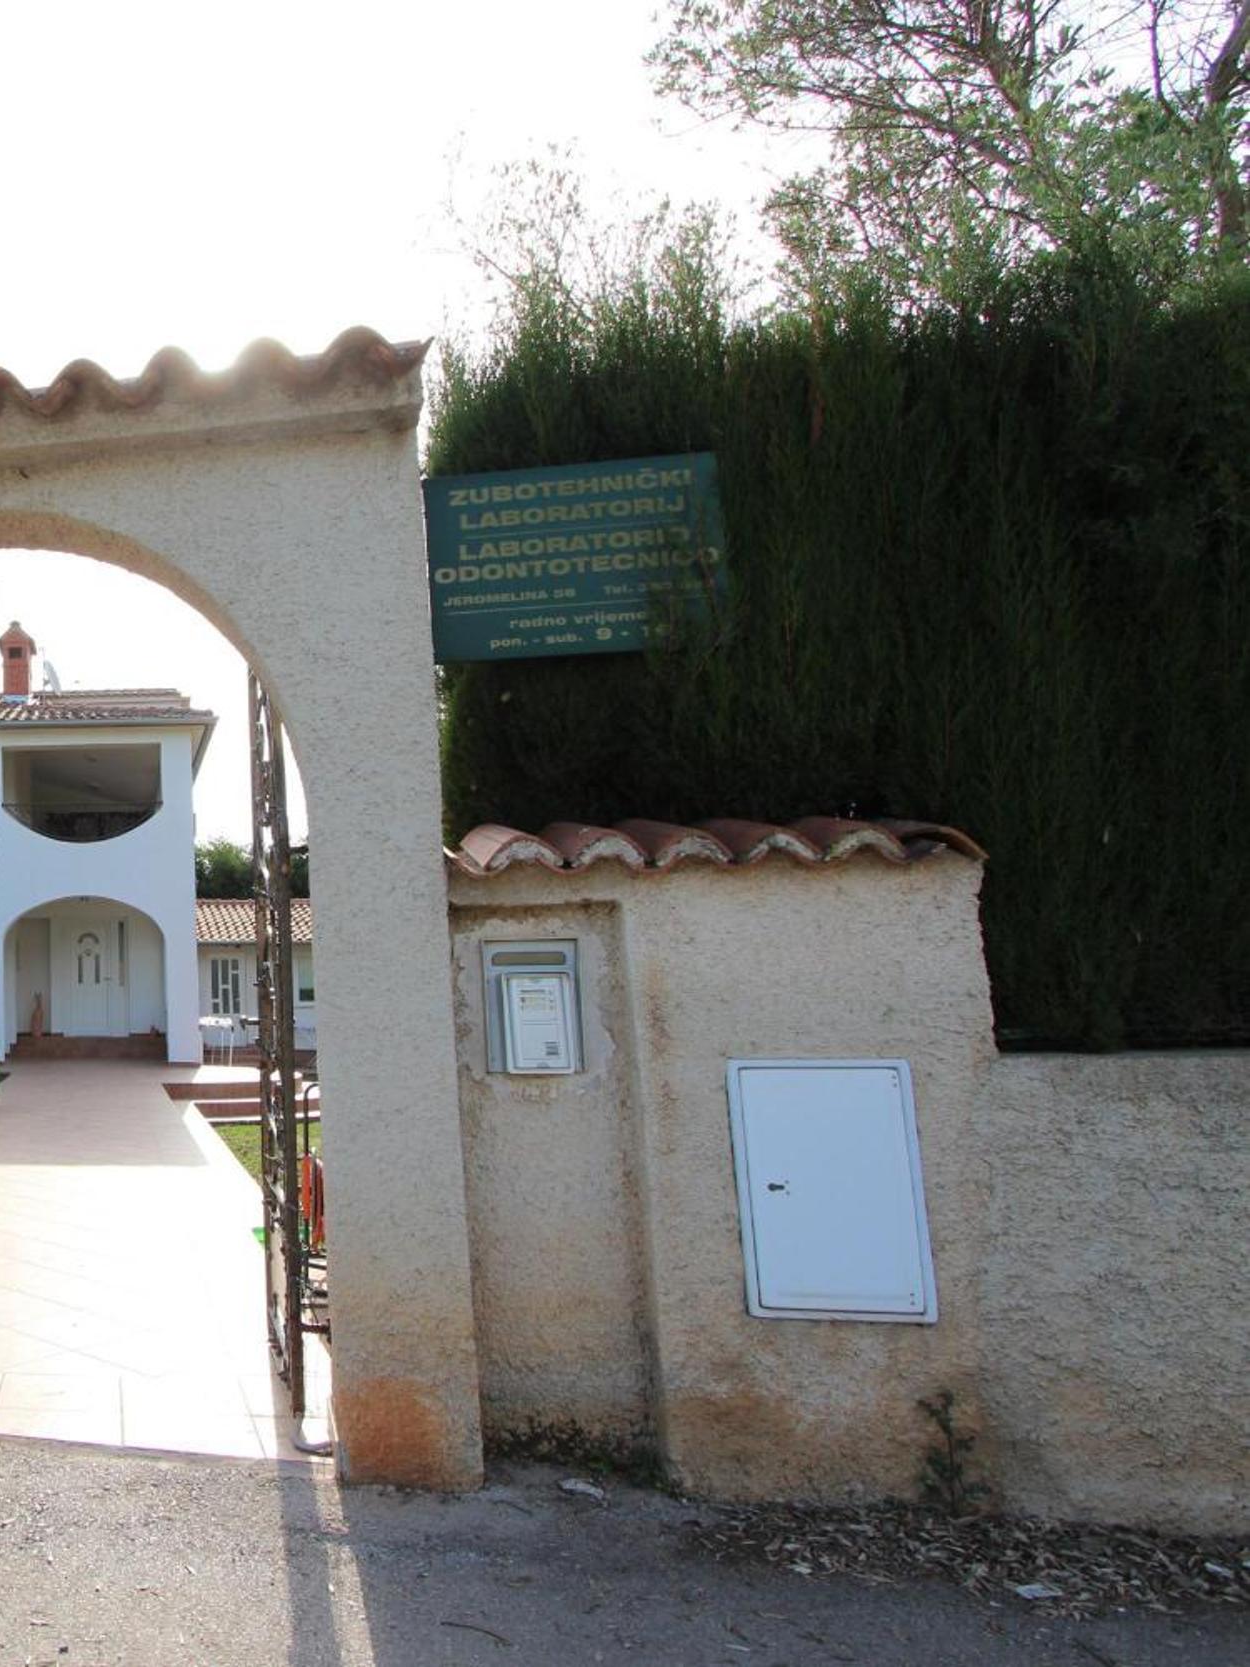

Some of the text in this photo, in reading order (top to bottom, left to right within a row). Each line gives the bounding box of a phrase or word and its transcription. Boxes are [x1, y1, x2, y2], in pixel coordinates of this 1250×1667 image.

[449, 468, 693, 506] ZUBOTEHNIČKI
[459, 496, 685, 531] LABORATORIJ
[509, 614, 566, 629] radno
[490, 637, 527, 650] pon.
[596, 626, 613, 641] 9
